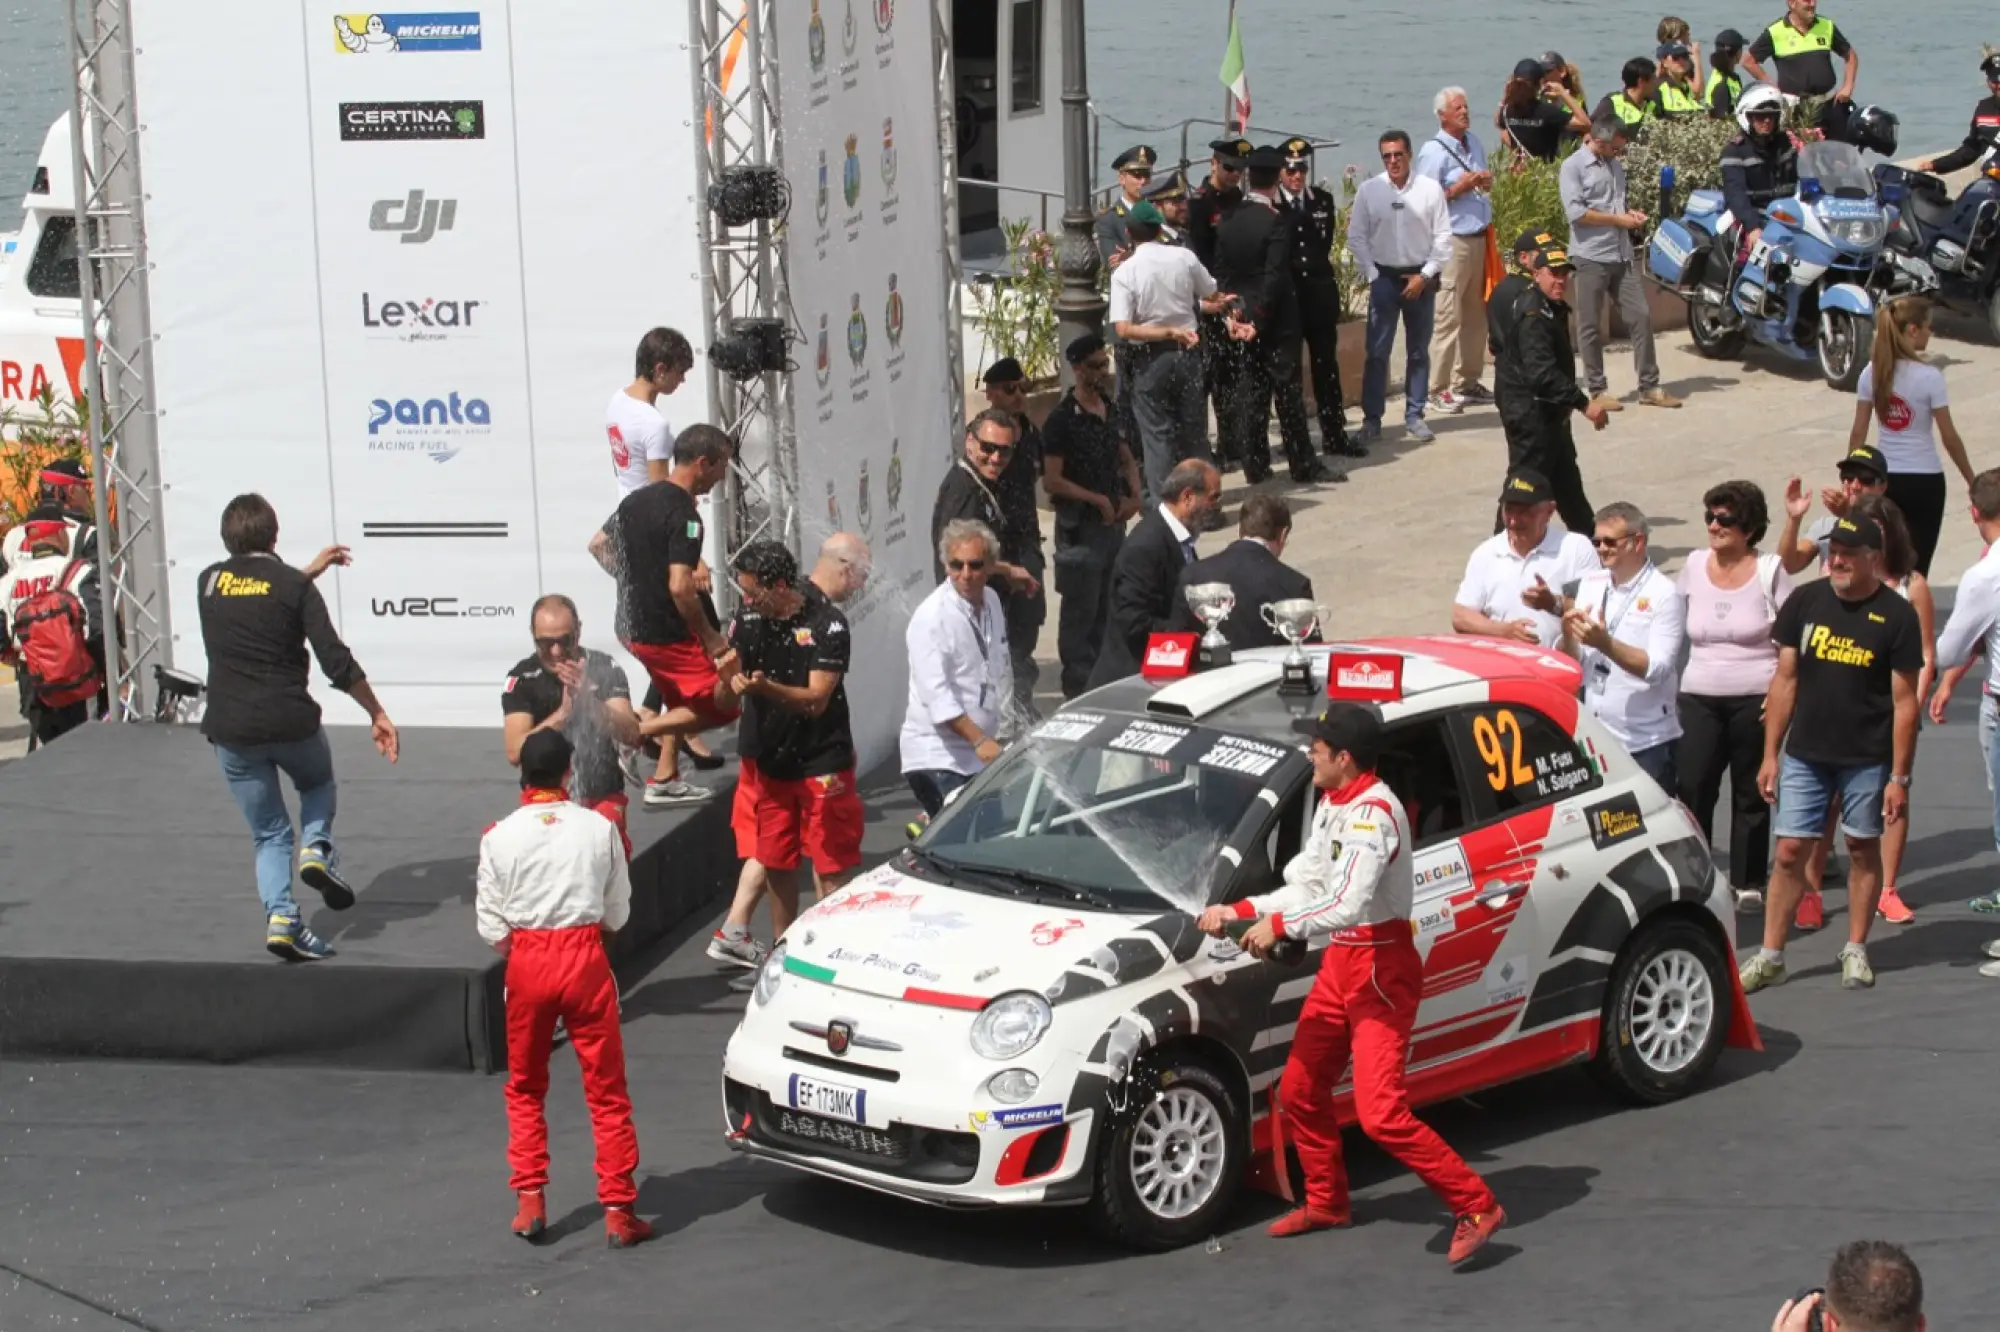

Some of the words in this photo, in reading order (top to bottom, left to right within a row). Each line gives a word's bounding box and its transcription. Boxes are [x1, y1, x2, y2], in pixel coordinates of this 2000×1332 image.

[397, 25, 480, 37] MICHELIN
[348, 110, 452, 124] CERTINA
[362, 292, 481, 327] Lexar
[368, 391, 491, 434] panta
[368, 440, 415, 451] RACING
[420, 439, 449, 450] FUEL
[1217, 735, 1286, 758] PETRONAS
[1473, 709, 1535, 791] 92
[800, 1081, 814, 1107] EF
[817, 1087, 855, 1118] 173MK
[1004, 1109, 1062, 1123] MICHELIN
